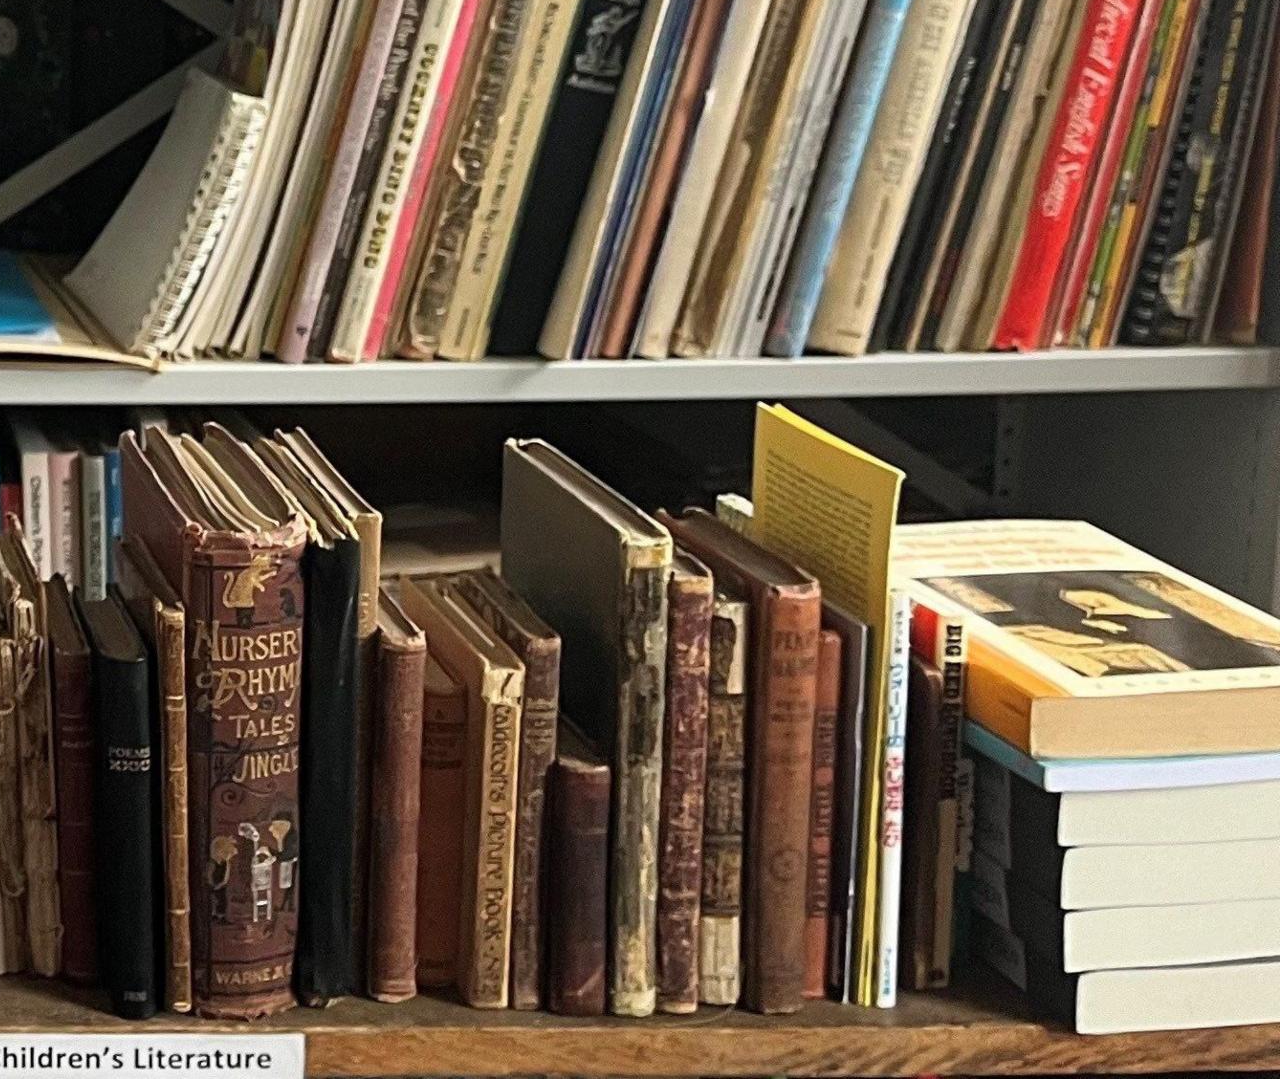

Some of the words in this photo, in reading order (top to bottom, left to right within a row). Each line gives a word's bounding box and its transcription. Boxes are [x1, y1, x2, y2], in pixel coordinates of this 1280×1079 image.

[1059, 66, 1113, 157] English
[377, 148, 413, 207] DING
[1038, 151, 1087, 223] Songs
[358, 207, 395, 272] DONG
[944, 624, 963, 657] BIG
[227, 714, 295, 739] TALES
[487, 811, 507, 882] Picture
[483, 887, 505, 942] Book
[134, 1046, 272, 1070] Literature
